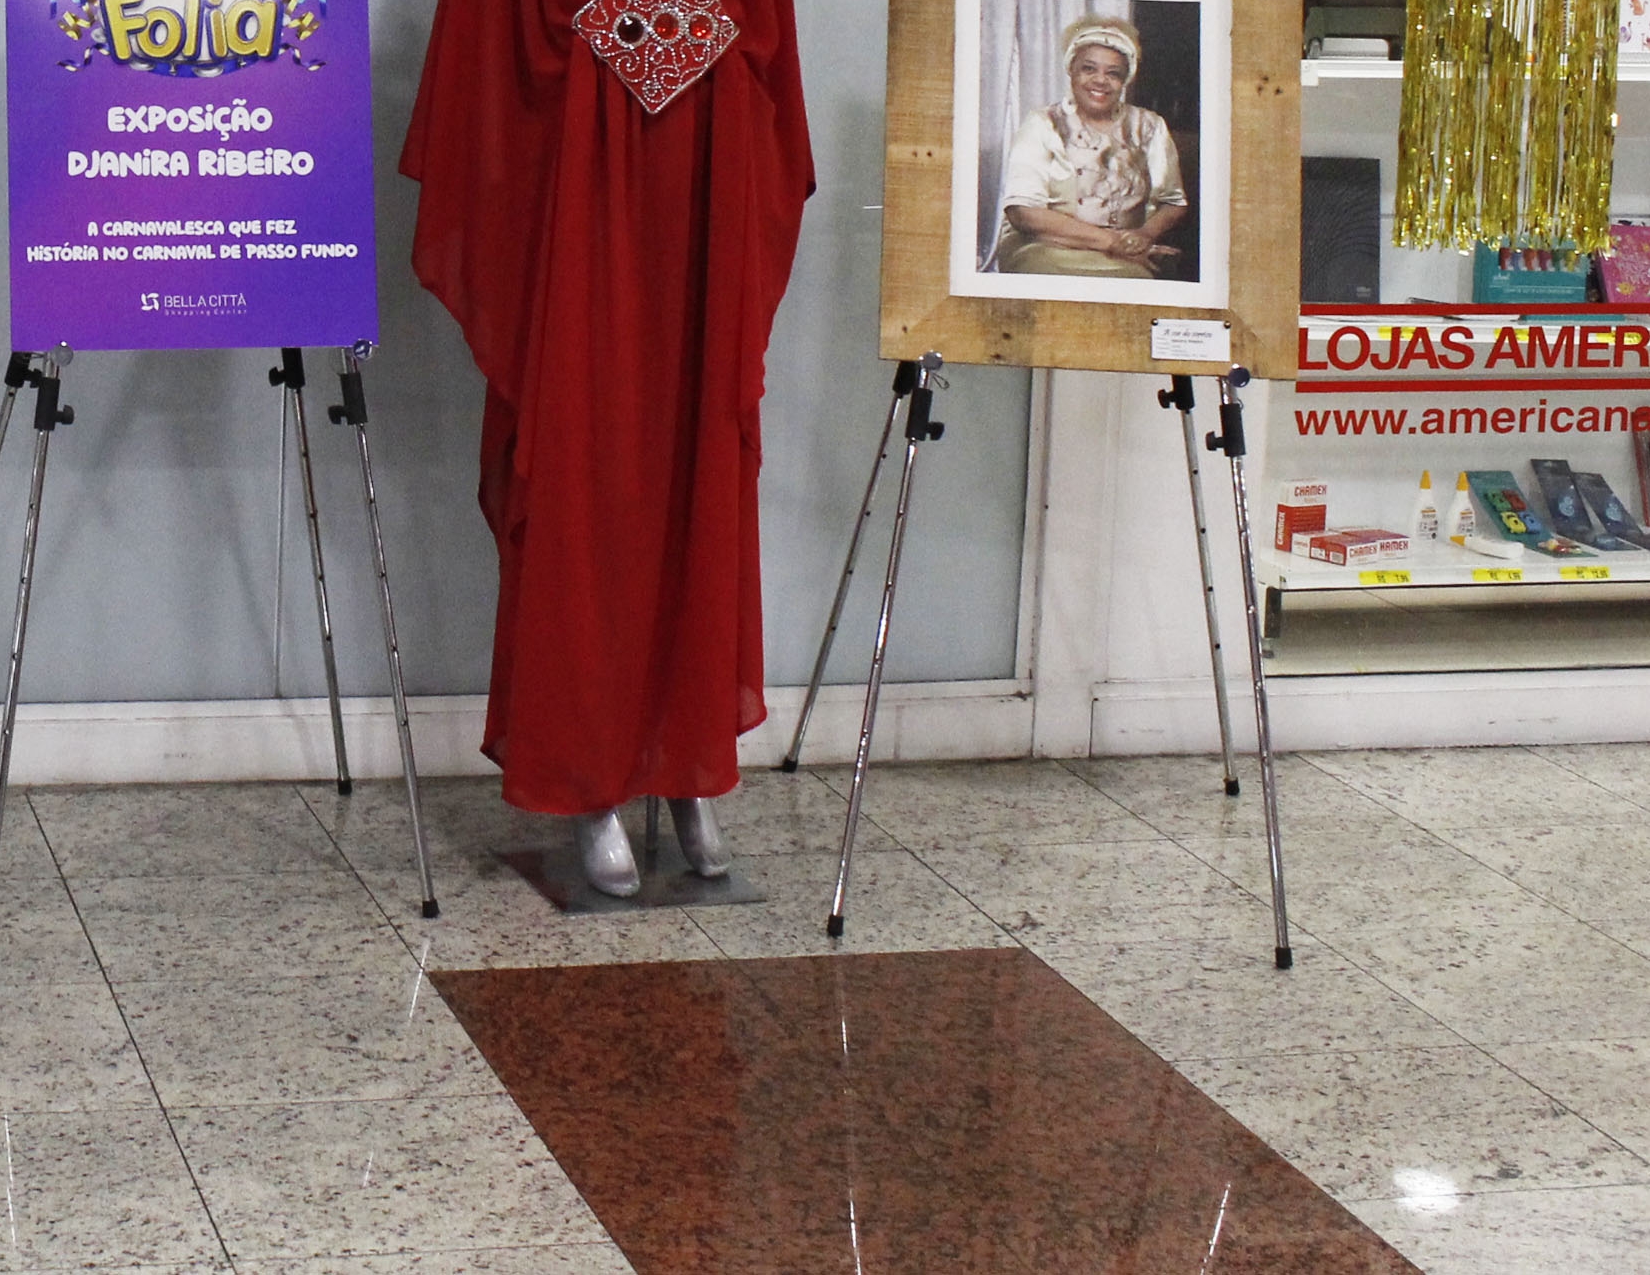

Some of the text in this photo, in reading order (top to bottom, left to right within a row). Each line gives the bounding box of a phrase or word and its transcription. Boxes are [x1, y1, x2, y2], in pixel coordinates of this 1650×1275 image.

[107, 98, 273, 141] EXPOSIÇÃO
[68, 147, 315, 178] DJANIRA RIBEIRO
[87, 219, 298, 238] A CARNAVALESCA QUE FEZ
[26, 242, 359, 263] HISTÓRIA NO CARNAVAL DE PASSO FUNDO
[163, 295, 207, 307] BELLA
[1297, 325, 1476, 370] LOJAS
